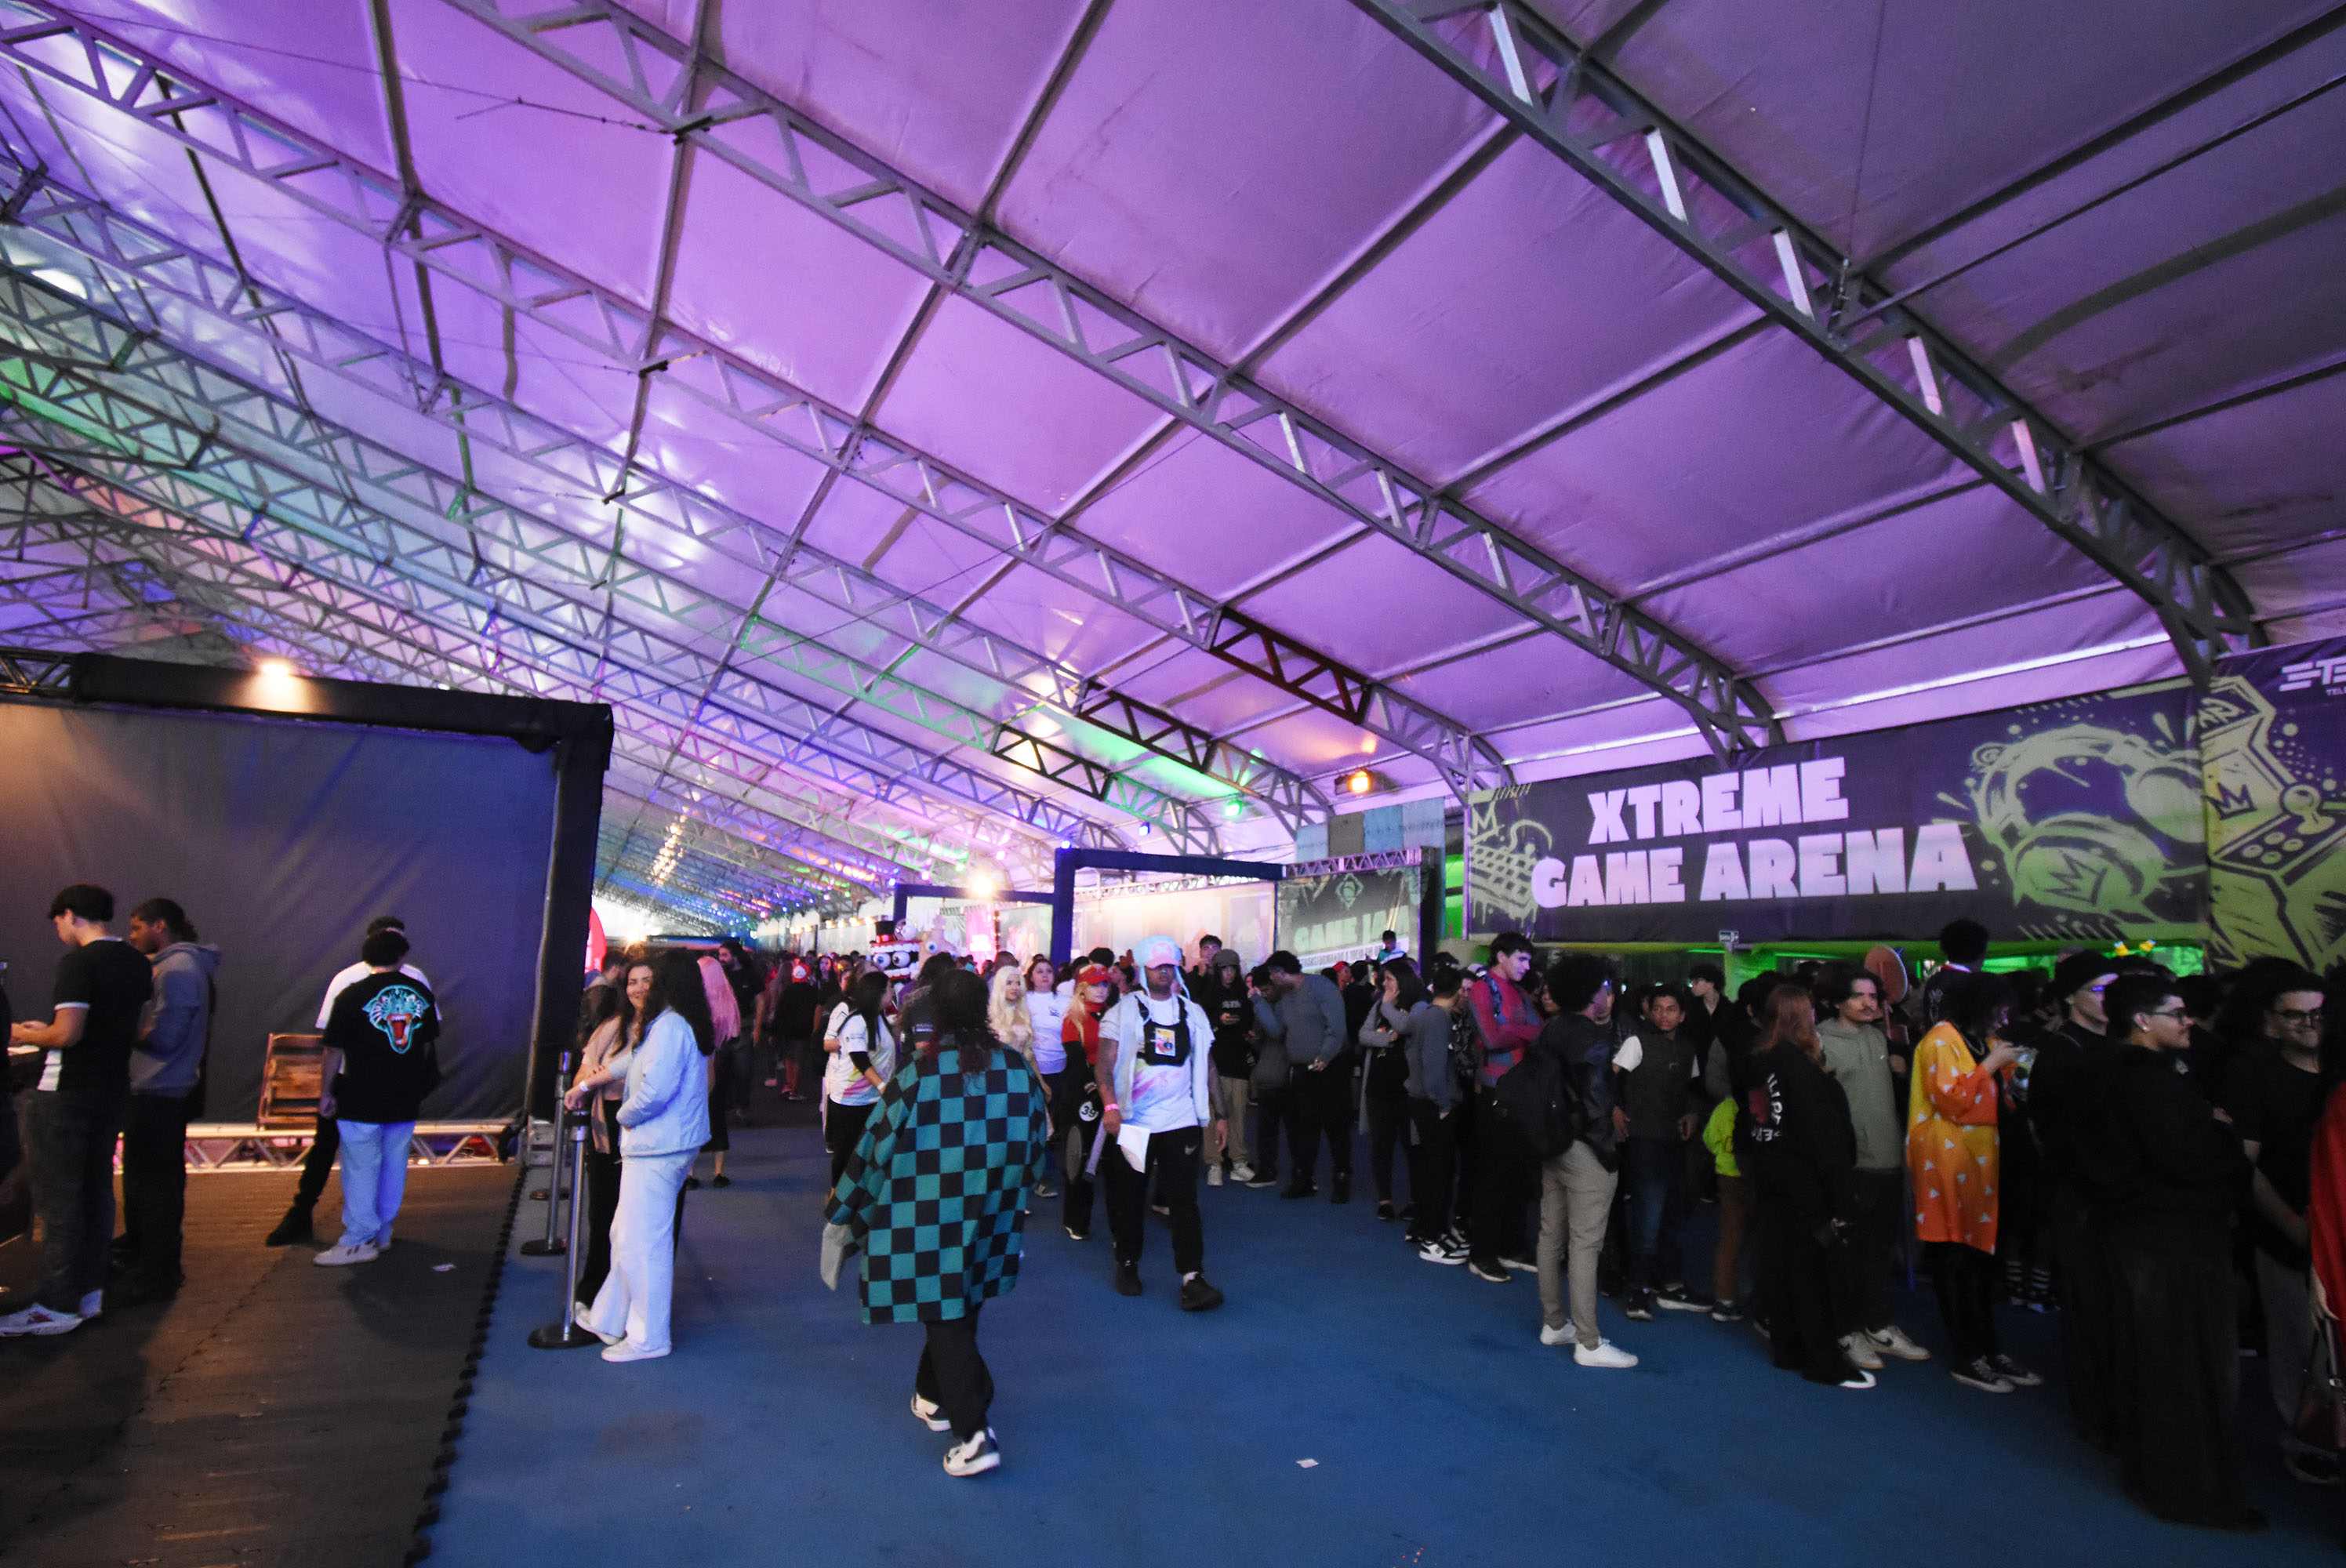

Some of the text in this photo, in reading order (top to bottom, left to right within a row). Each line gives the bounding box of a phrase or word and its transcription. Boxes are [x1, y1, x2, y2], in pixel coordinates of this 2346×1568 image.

[1588, 757, 1848, 844] XTREME
[1531, 822, 1978, 909] GAME ARENA
[1294, 916, 1357, 952] GAME
